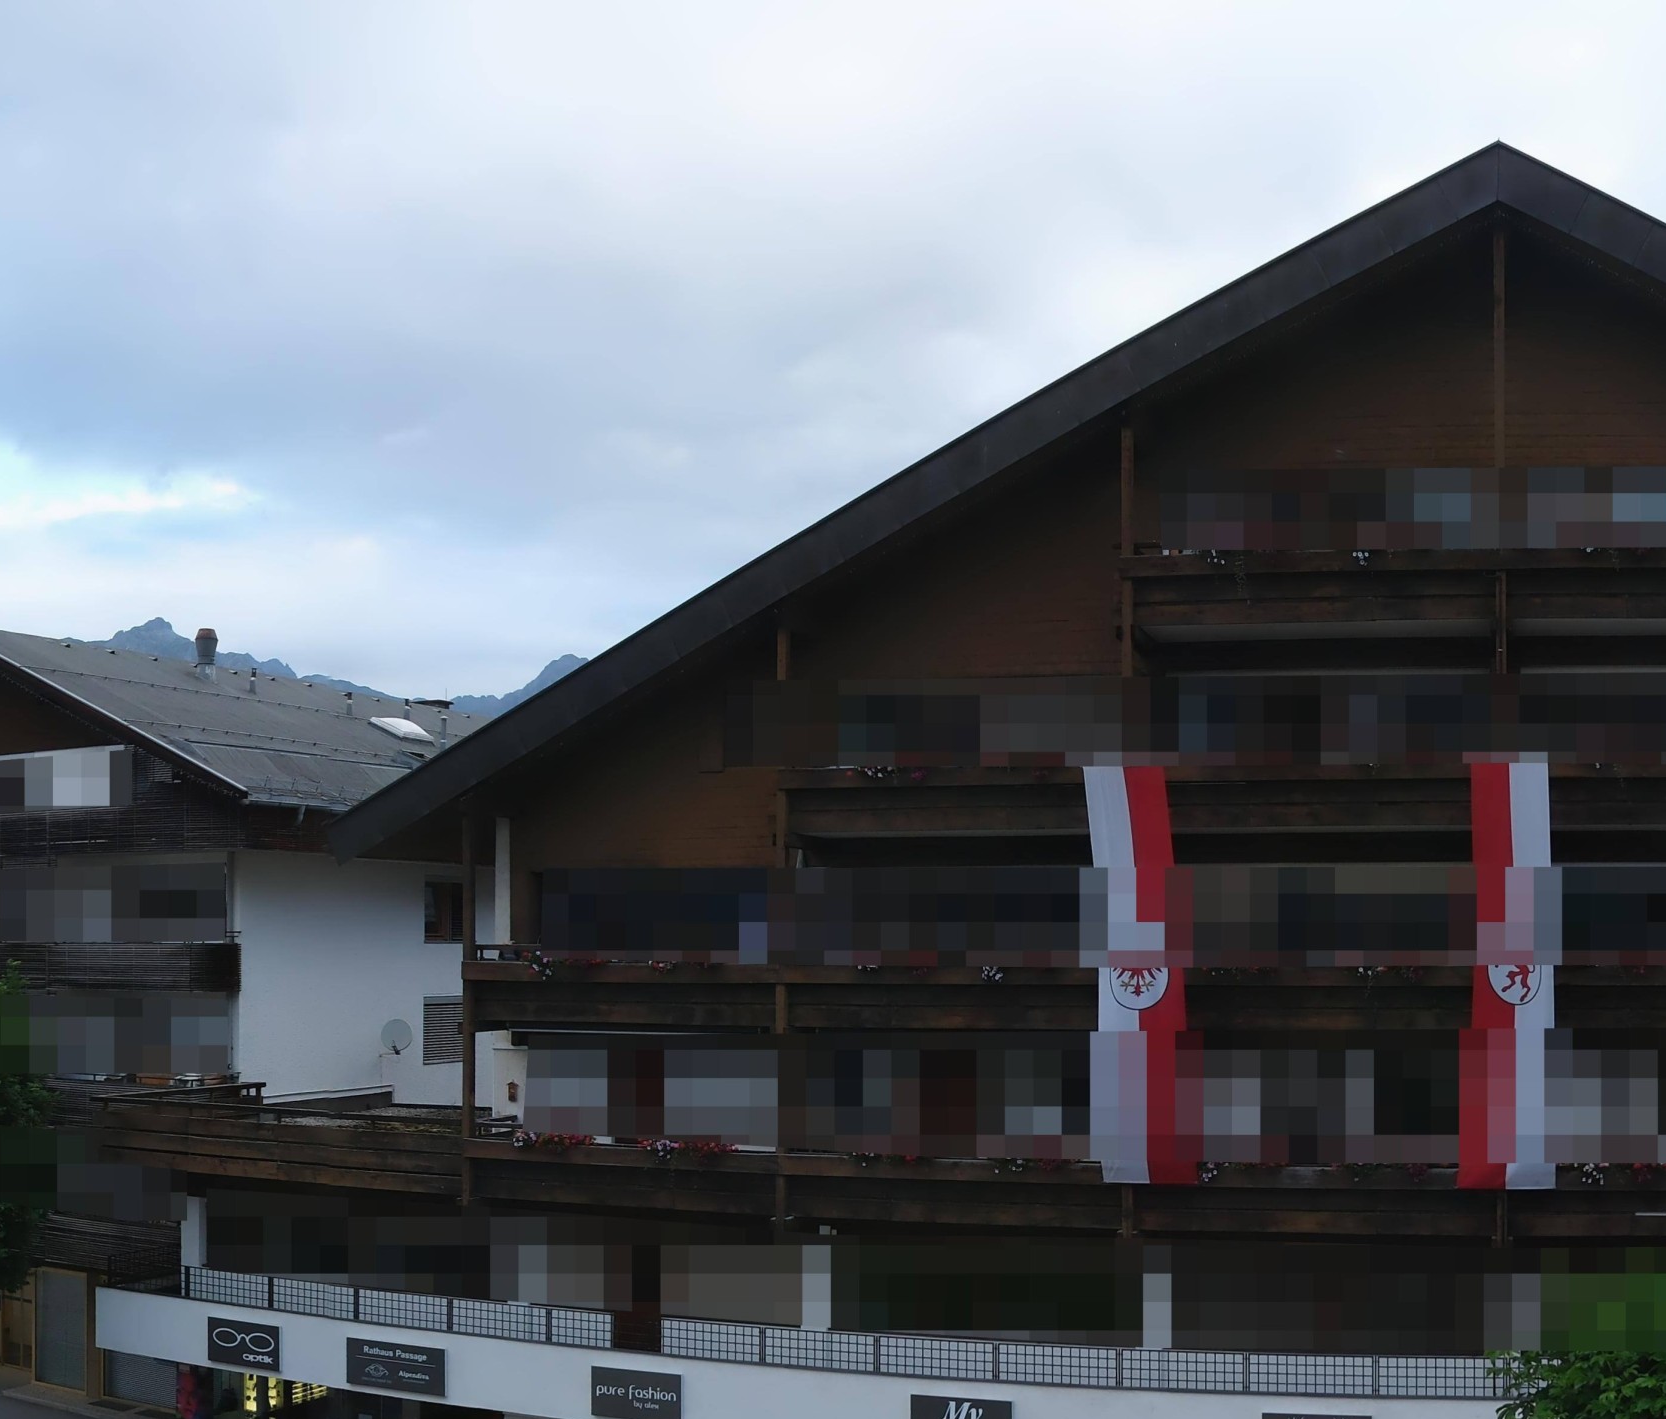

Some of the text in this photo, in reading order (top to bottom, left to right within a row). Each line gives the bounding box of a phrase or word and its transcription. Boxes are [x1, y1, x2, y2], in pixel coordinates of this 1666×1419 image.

[242, 1352, 274, 1365] optik
[363, 1345, 427, 1362] Rathaus Passage
[596, 1384, 677, 1402] pure fashion
[633, 1400, 659, 1410] by alex
